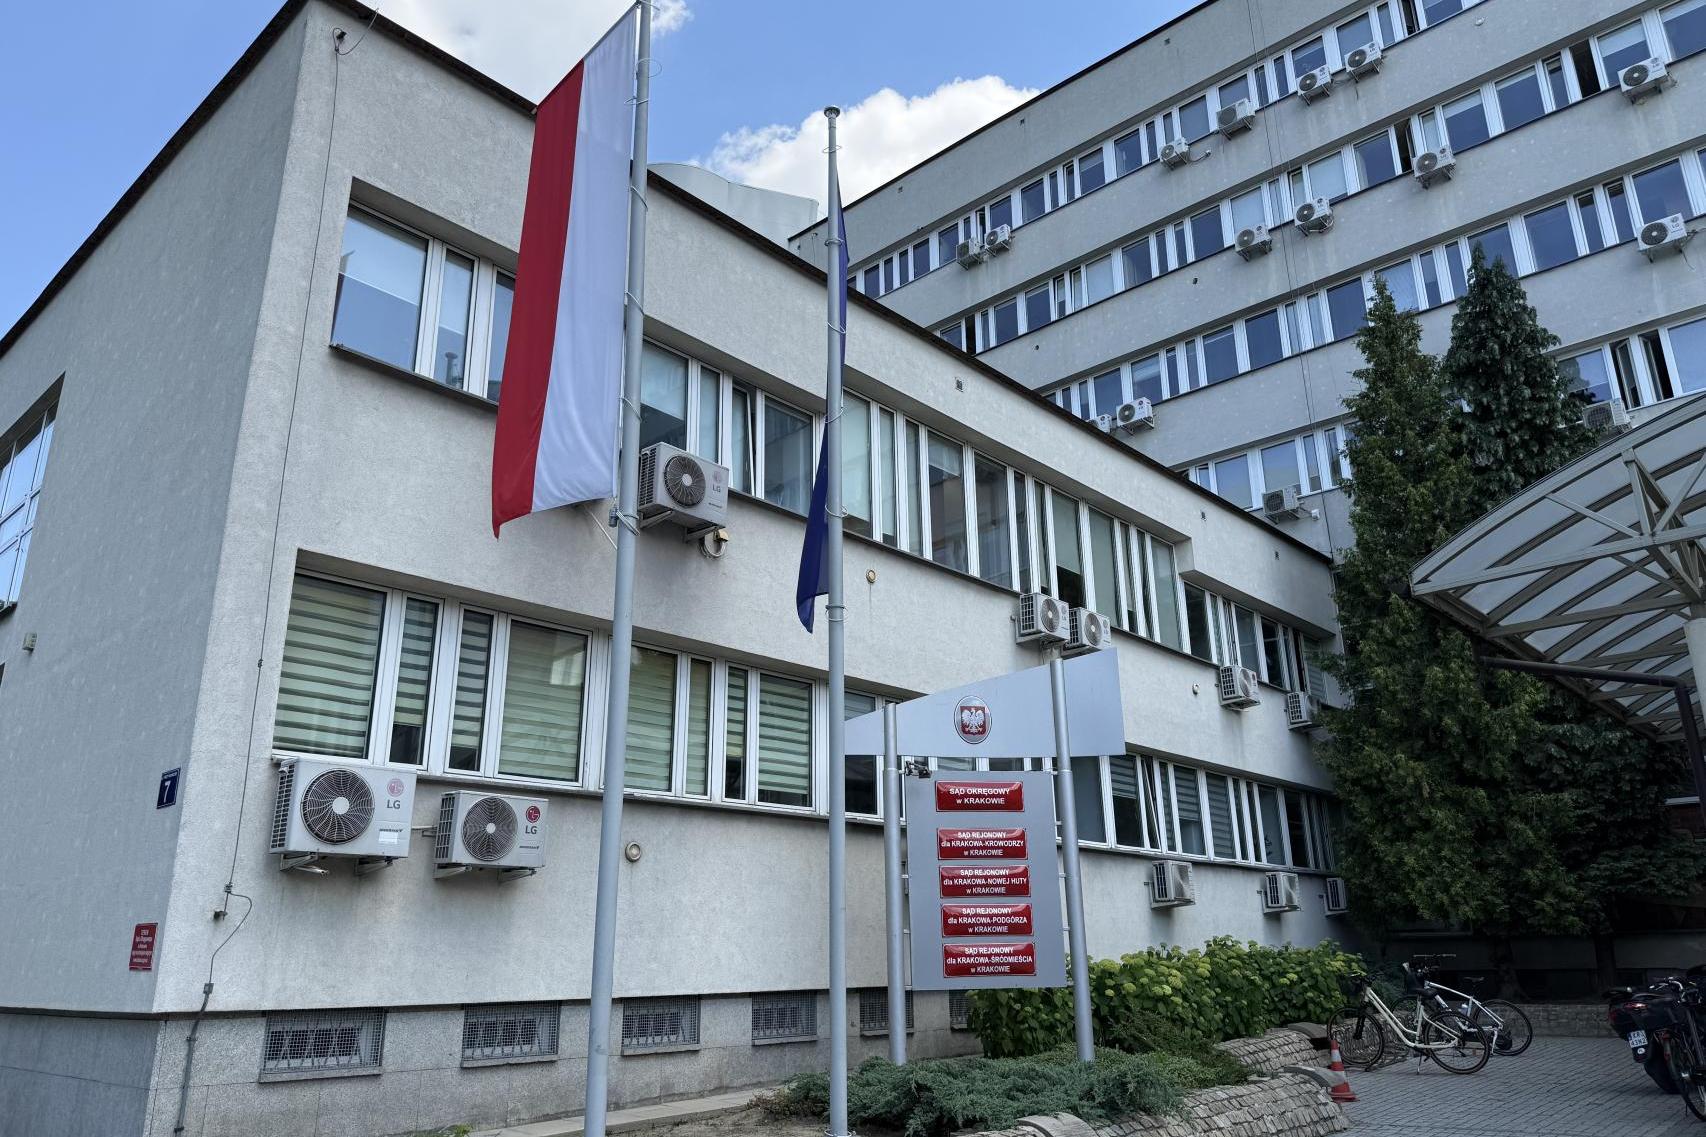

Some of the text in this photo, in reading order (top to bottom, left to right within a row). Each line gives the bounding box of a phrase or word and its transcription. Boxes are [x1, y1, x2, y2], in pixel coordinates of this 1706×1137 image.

[713, 484, 721, 493] LG
[163, 780, 171, 803] 7
[949, 788, 1010, 796] SĄD OKRĘGOWY
[386, 799, 401, 810] LG
[525, 825, 538, 835] LG
[960, 869, 973, 877] SĄD
[958, 915, 1027, 923] KRAKOWA-PODGÓRZA
[965, 947, 977, 955] SĄD
[957, 954, 1032, 963] KRAKOWA-ŚRÓDMIEŚCIA
[977, 965, 1010, 973] KRAKOWIE
